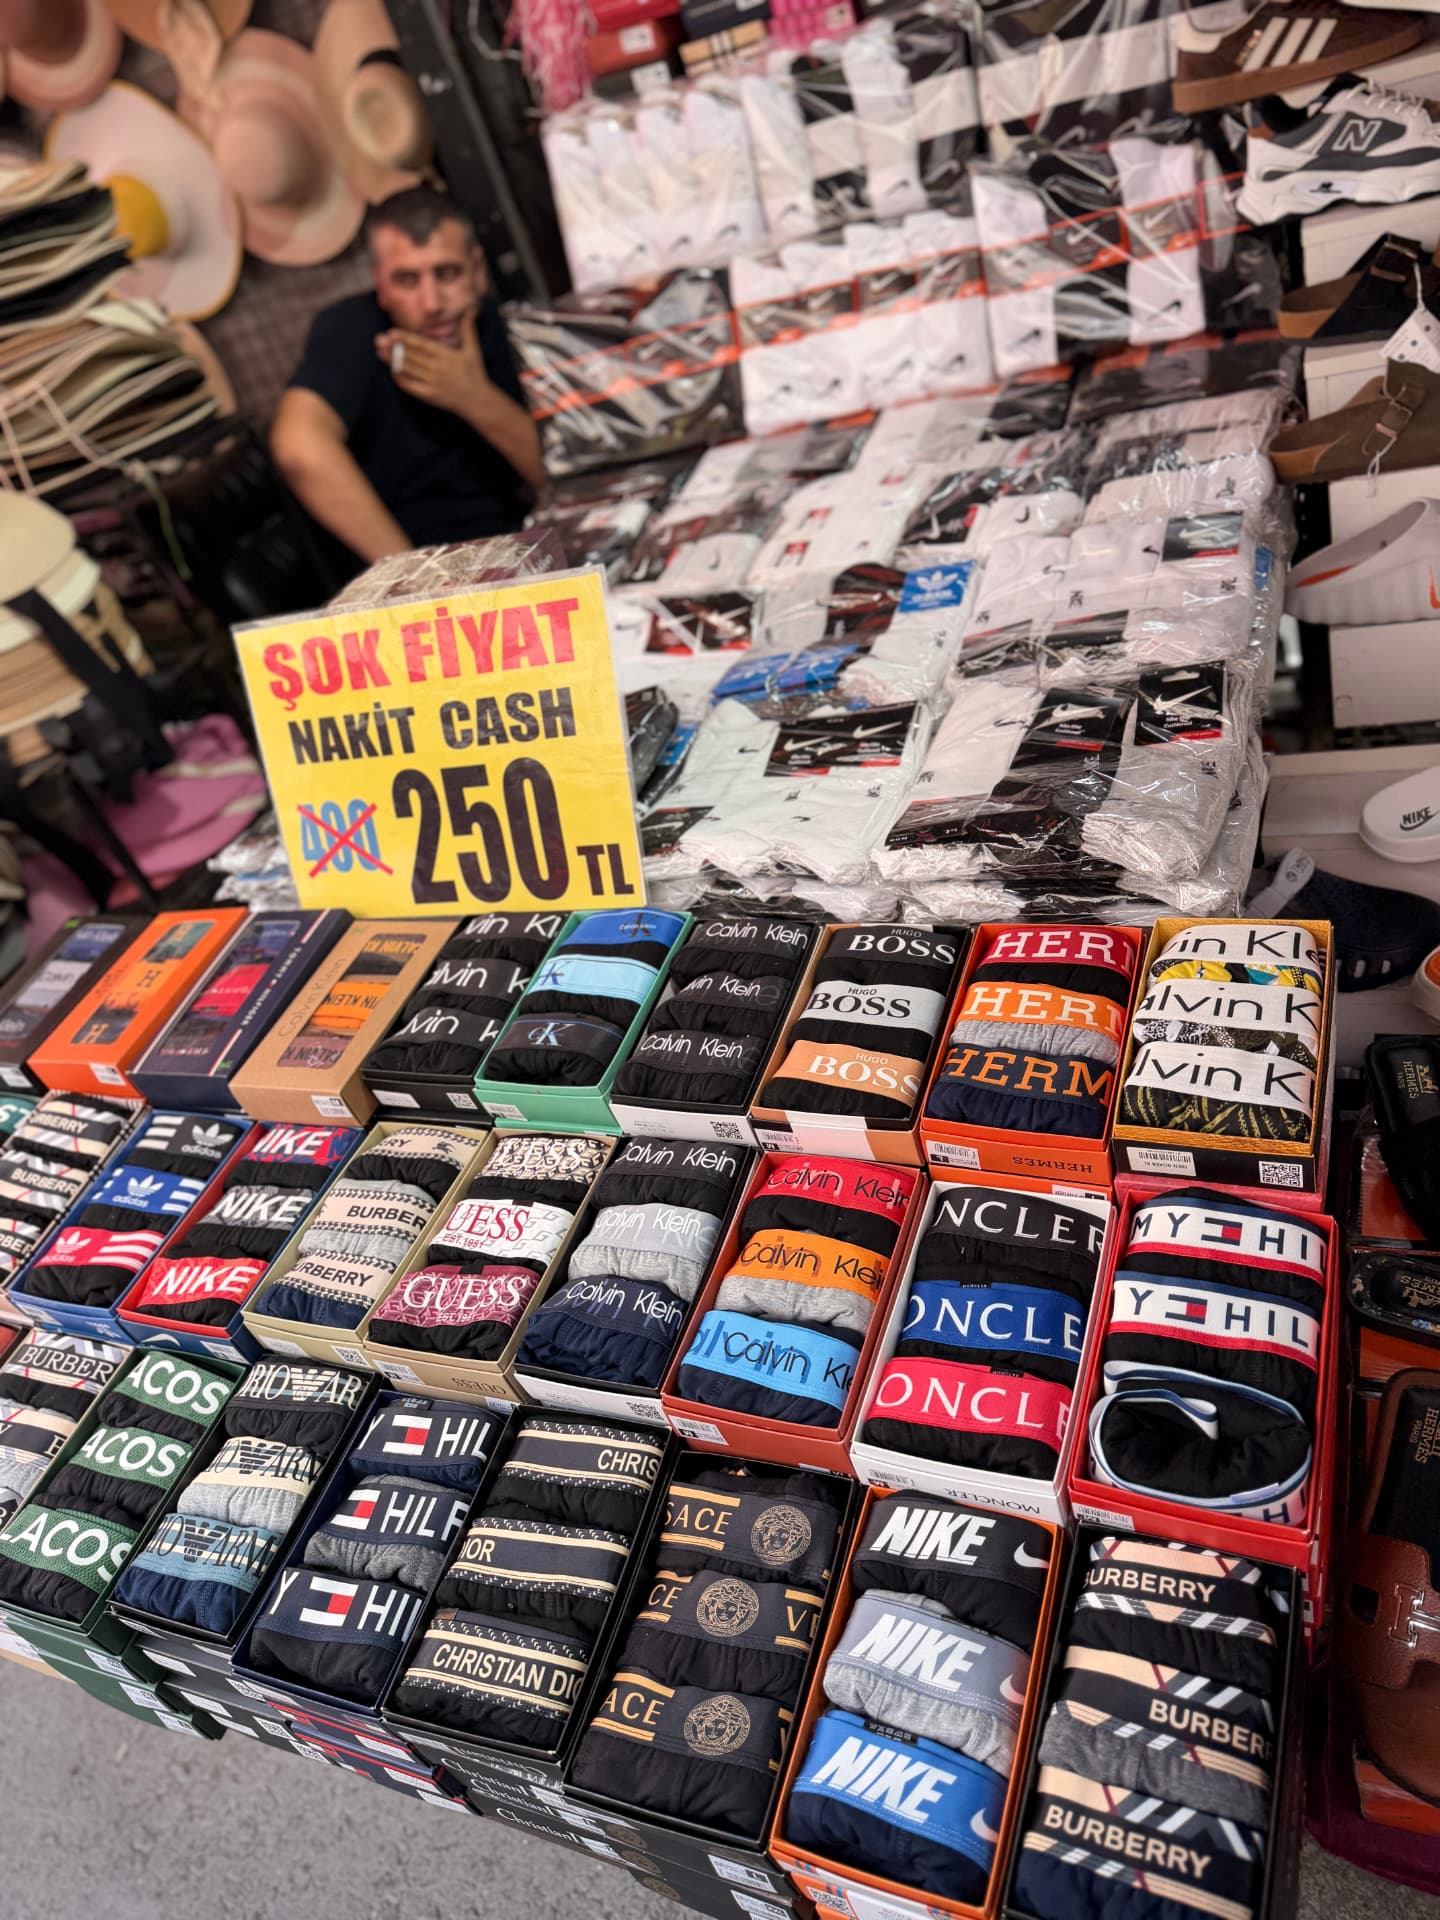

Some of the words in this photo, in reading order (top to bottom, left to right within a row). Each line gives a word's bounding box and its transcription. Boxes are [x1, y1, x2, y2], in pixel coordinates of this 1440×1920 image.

[263, 629, 391, 711] ŞOK
[401, 597, 579, 683] FİYAT
[288, 702, 415, 765] NAKİT
[440, 686, 577, 749] CASH
[392, 757, 569, 905] 250
[577, 844, 634, 896] TL
[1402, 806, 1431, 825] NIKE
[706, 921, 757, 940] Calvin
[765, 924, 809, 950] Klein
[847, 934, 956, 965] BOSS
[891, 928, 922, 938] HUGO
[719, 977, 761, 998] Klein
[847, 987, 878, 997] HUGO
[807, 992, 912, 1020] BOSS
[639, 1033, 692, 1055] Calvin
[700, 1037, 744, 1060] Klein
[855, 1052, 889, 1066] HUGO
[807, 1055, 921, 1095] BOSS
[1264, 1062, 1306, 1103] K
[683, 1146, 737, 1178] Klein
[1012, 1156, 1094, 1174] HERMES
[767, 1168, 841, 1194] Calvin
[212, 1190, 314, 1224] NIKE
[652, 1208, 702, 1237] Klein
[739, 1241, 819, 1270] Calvin
[152, 1264, 262, 1296] NIKE
[404, 1275, 528, 1311] GUESS
[566, 1278, 626, 1308] Calvin
[632, 1293, 683, 1331] Klein
[1129, 1287, 1154, 1316] Y
[723, 1331, 811, 1372] Calvin
[82, 1428, 193, 1478] ACOS
[944, 1487, 1041, 1515] MONCLER
[870, 1506, 997, 1566] NIKE
[269, 1571, 300, 1615] Y
[1083, 1566, 1217, 1604] URBERRY
[432, 1643, 547, 1692] CHRISTIAN
[848, 1613, 987, 1693] NIKE
[810, 1736, 958, 1824] NIKE
[1044, 1803, 1212, 1879] BURBERRY
